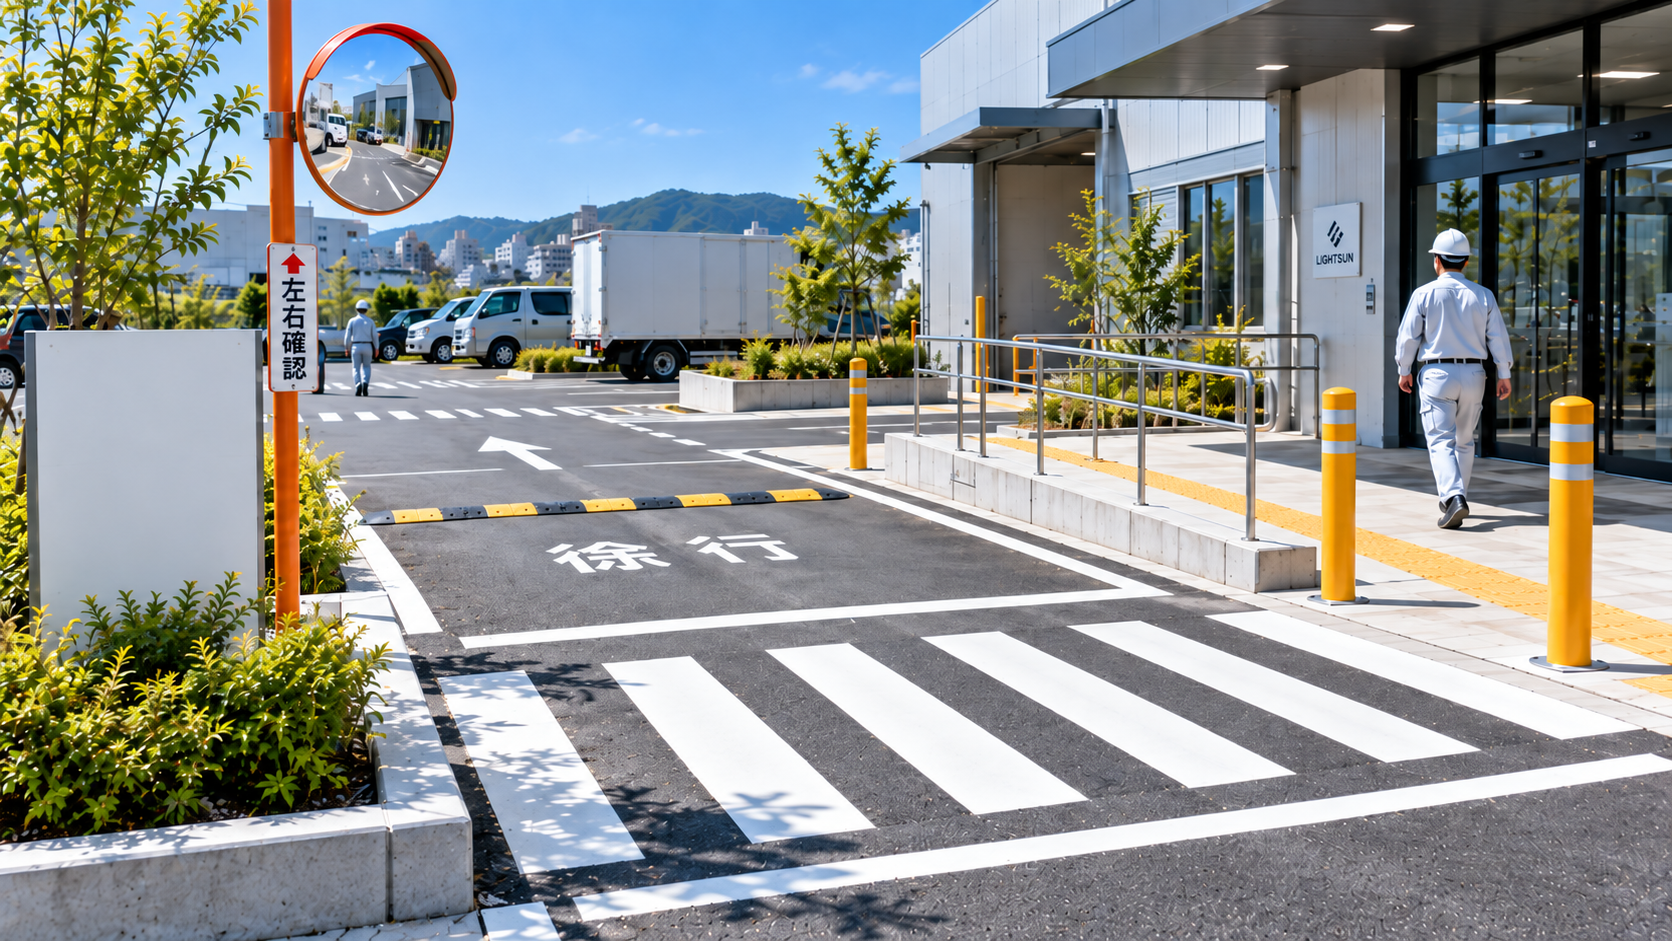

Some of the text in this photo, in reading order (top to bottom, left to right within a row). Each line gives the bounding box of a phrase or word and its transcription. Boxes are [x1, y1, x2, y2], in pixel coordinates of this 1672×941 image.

[1316, 253, 1354, 265] LIGHTSUN
[282, 277, 307, 380] 左右確認
[545, 533, 799, 574] 徐行
